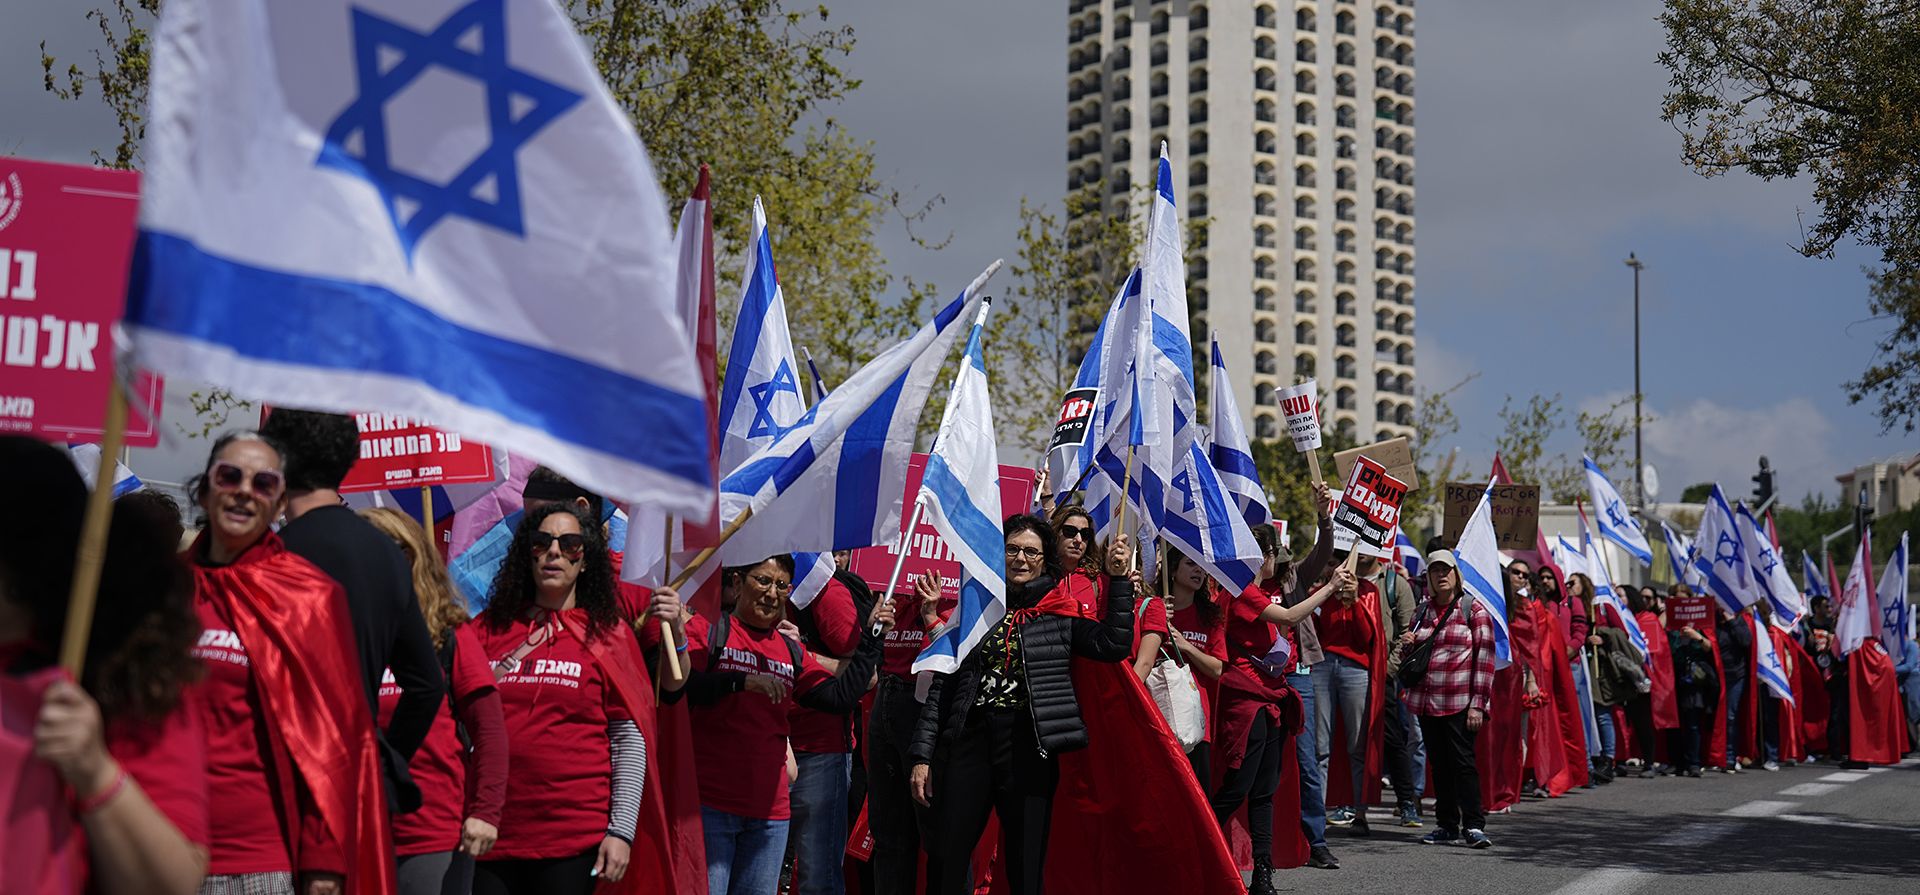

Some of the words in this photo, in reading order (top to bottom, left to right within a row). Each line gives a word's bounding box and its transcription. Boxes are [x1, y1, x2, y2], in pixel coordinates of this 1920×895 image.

[0, 314, 99, 371] אלט
[1280, 394, 1311, 417] עוצ
[360, 433, 432, 459] המחאות
[436, 431, 462, 453] של
[1461, 504, 1534, 518] DTROYER
[197, 629, 245, 651] אבק
[534, 659, 582, 677] מאבק
